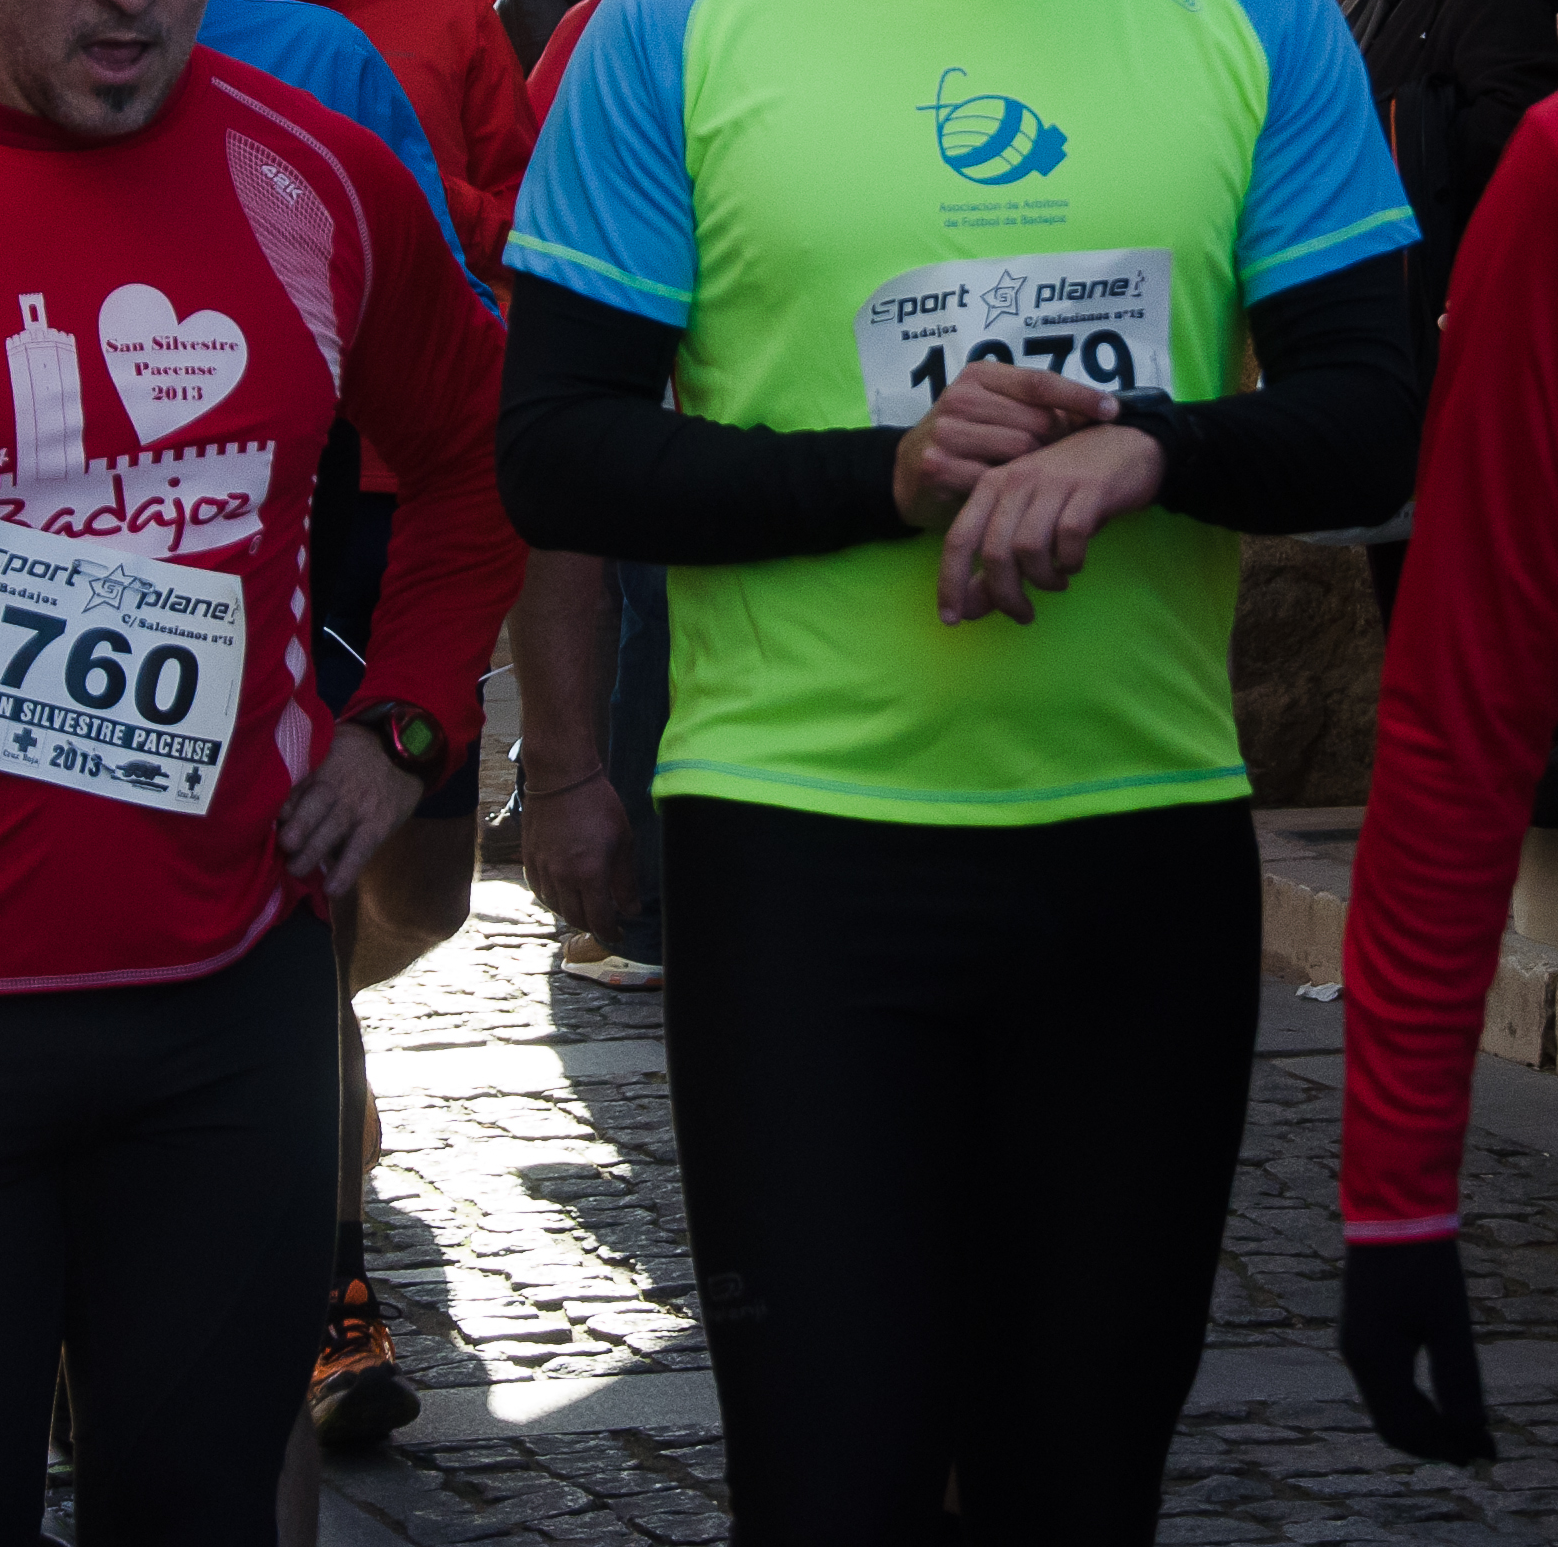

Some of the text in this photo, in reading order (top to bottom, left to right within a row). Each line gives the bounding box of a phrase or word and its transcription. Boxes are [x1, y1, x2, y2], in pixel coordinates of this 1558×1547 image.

[261, 163, 303, 200] 42K
[105, 335, 239, 353] San Silvestre
[901, 324, 957, 341] Badajoz
[134, 361, 218, 377] Pacense
[151, 385, 204, 401] 2013
[0, 603, 199, 726] 760
[20, 702, 124, 746] SILVESTRE
[132, 728, 213, 764] PACENSE
[49, 741, 103, 779] 2013
